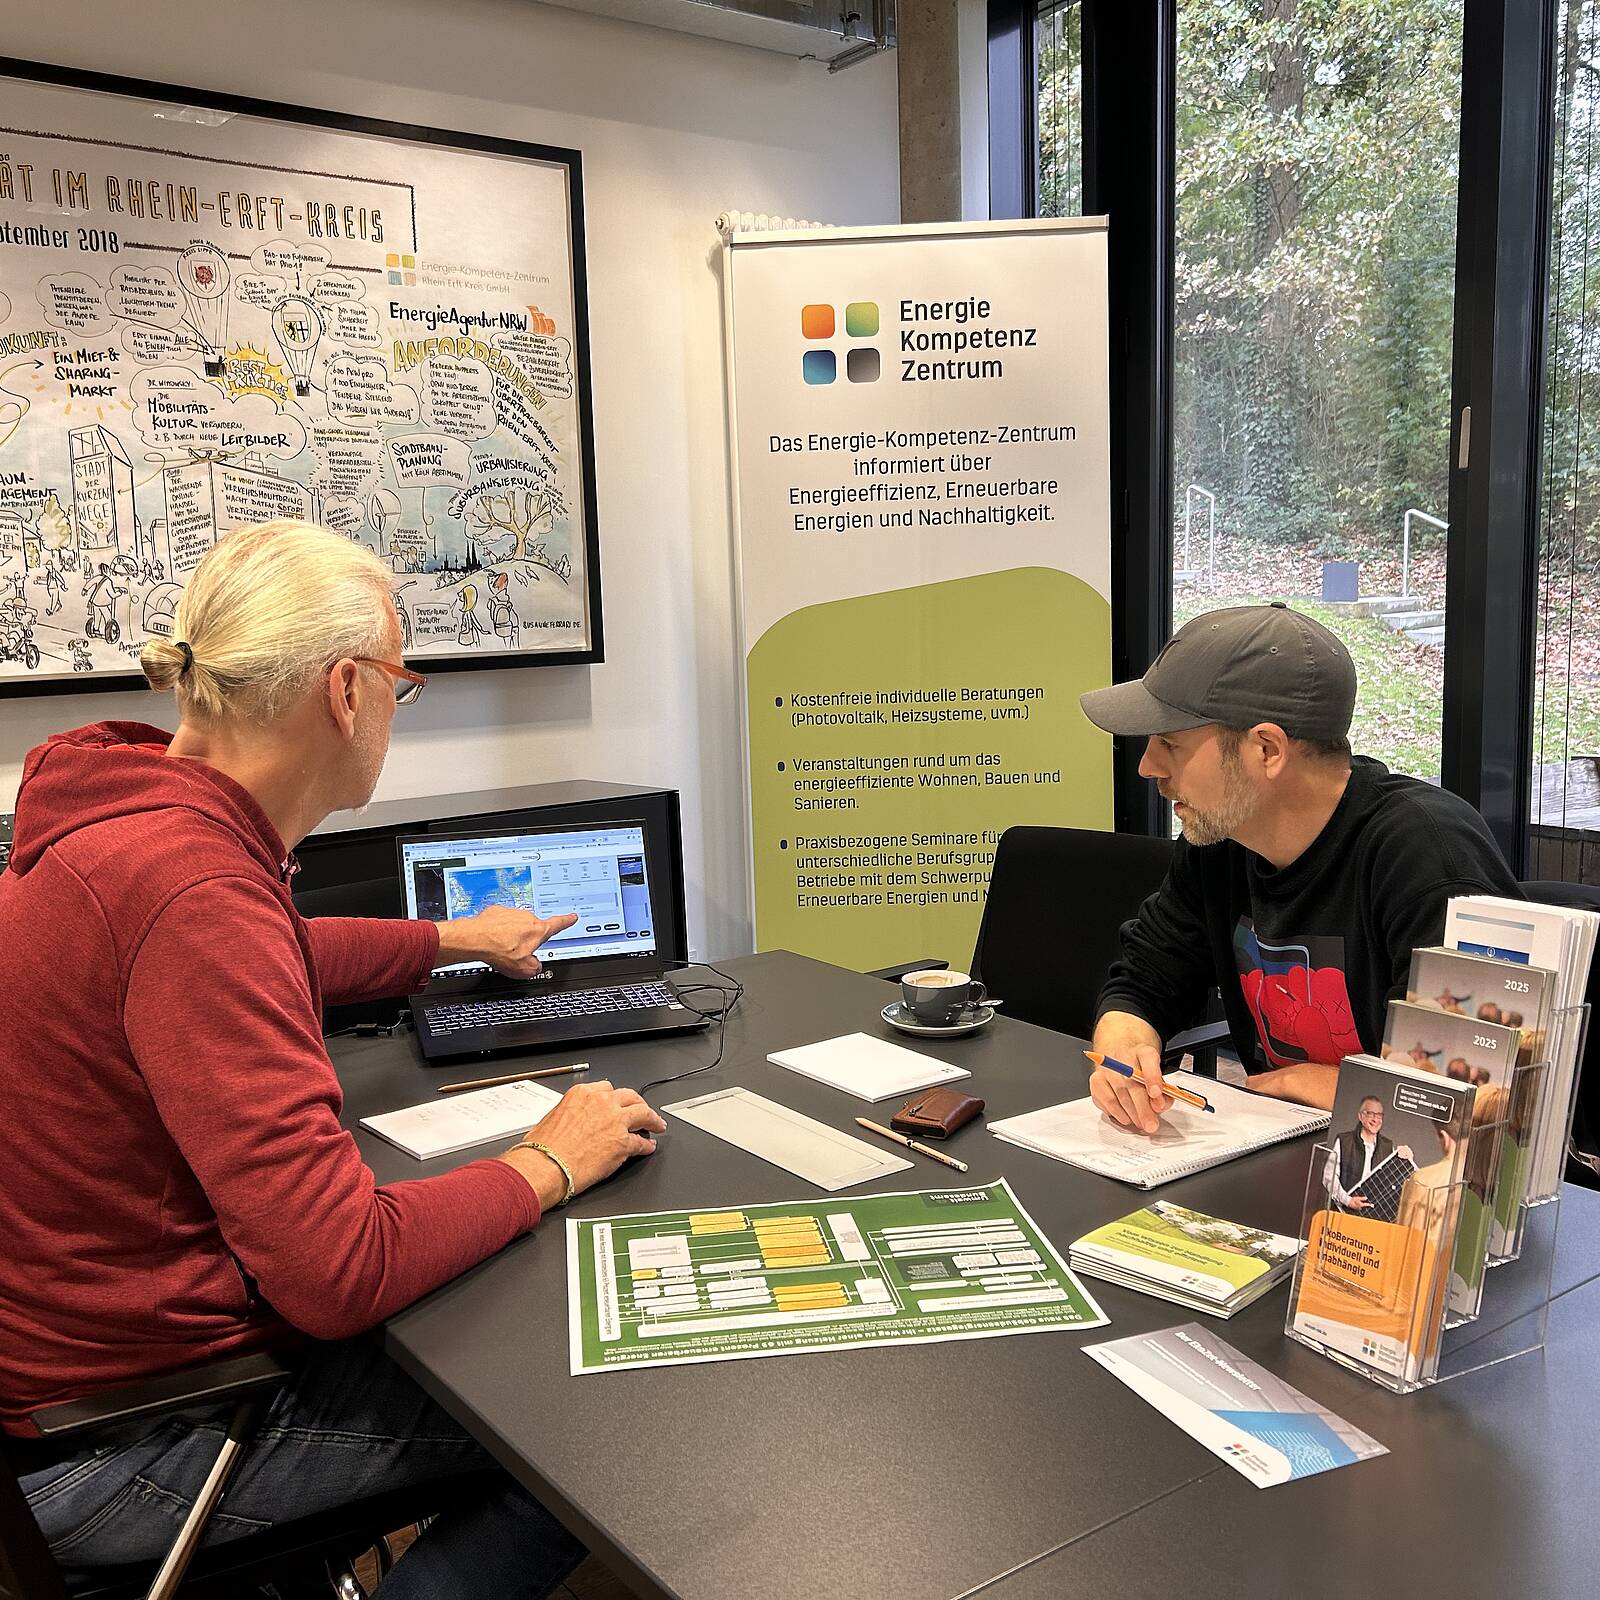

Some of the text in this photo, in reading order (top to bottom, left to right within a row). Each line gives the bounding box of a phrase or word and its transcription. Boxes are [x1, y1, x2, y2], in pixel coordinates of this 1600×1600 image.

[52, 169, 90, 210] IM
[106, 175, 384, 244] RHEIN-ERFT-KREIS
[77, 227, 120, 254] 2018
[899, 296, 991, 324] Energie
[900, 328, 1038, 354] Kompetenz
[53, 351, 74, 364] EIN
[901, 359, 1004, 382] Zentrum
[69, 384, 118, 398] MARKT
[152, 414, 198, 431] KULTUR
[391, 442, 449, 456] STADTBAHN-
[769, 425, 1077, 453] Das Energie-Kompetenz-Zentrum
[75, 460, 107, 478] STADT
[396, 454, 442, 471] PLANUNG
[853, 453, 992, 477] informiert über
[84, 479, 100, 488] DER
[789, 478, 1059, 507] Energieeffizienz, Erneuerbare
[76, 487, 110, 503] KURZEN
[78, 502, 110, 521] WEGE
[794, 503, 1056, 533] Energien und Nachhaltigkeit.
[790, 687, 1045, 707] Kostenfreie individuelle Beratungen
[791, 704, 1030, 727] (Photovoltaik, Heizsysteme, uvm.)
[792, 752, 1001, 772] Veranstaltungen rund um das
[793, 769, 1061, 793] energieeffiziente Wohnen, Bauen und
[793, 796, 860, 811] Sanieren.
[795, 830, 1001, 851] Praxisbezogene Seminare für
[795, 850, 995, 870] unterschiedliche Berufsgrup
[796, 869, 992, 889] Betriebe mit dem Schwerpu
[797, 892, 883, 908] Erneuerbare
[886, 890, 949, 907] Energien
[951, 889, 979, 904] und
[1503, 979, 1530, 994] 2025
[1472, 1035, 1498, 1050] 2025
[1363, 1256, 1380, 1269] und
